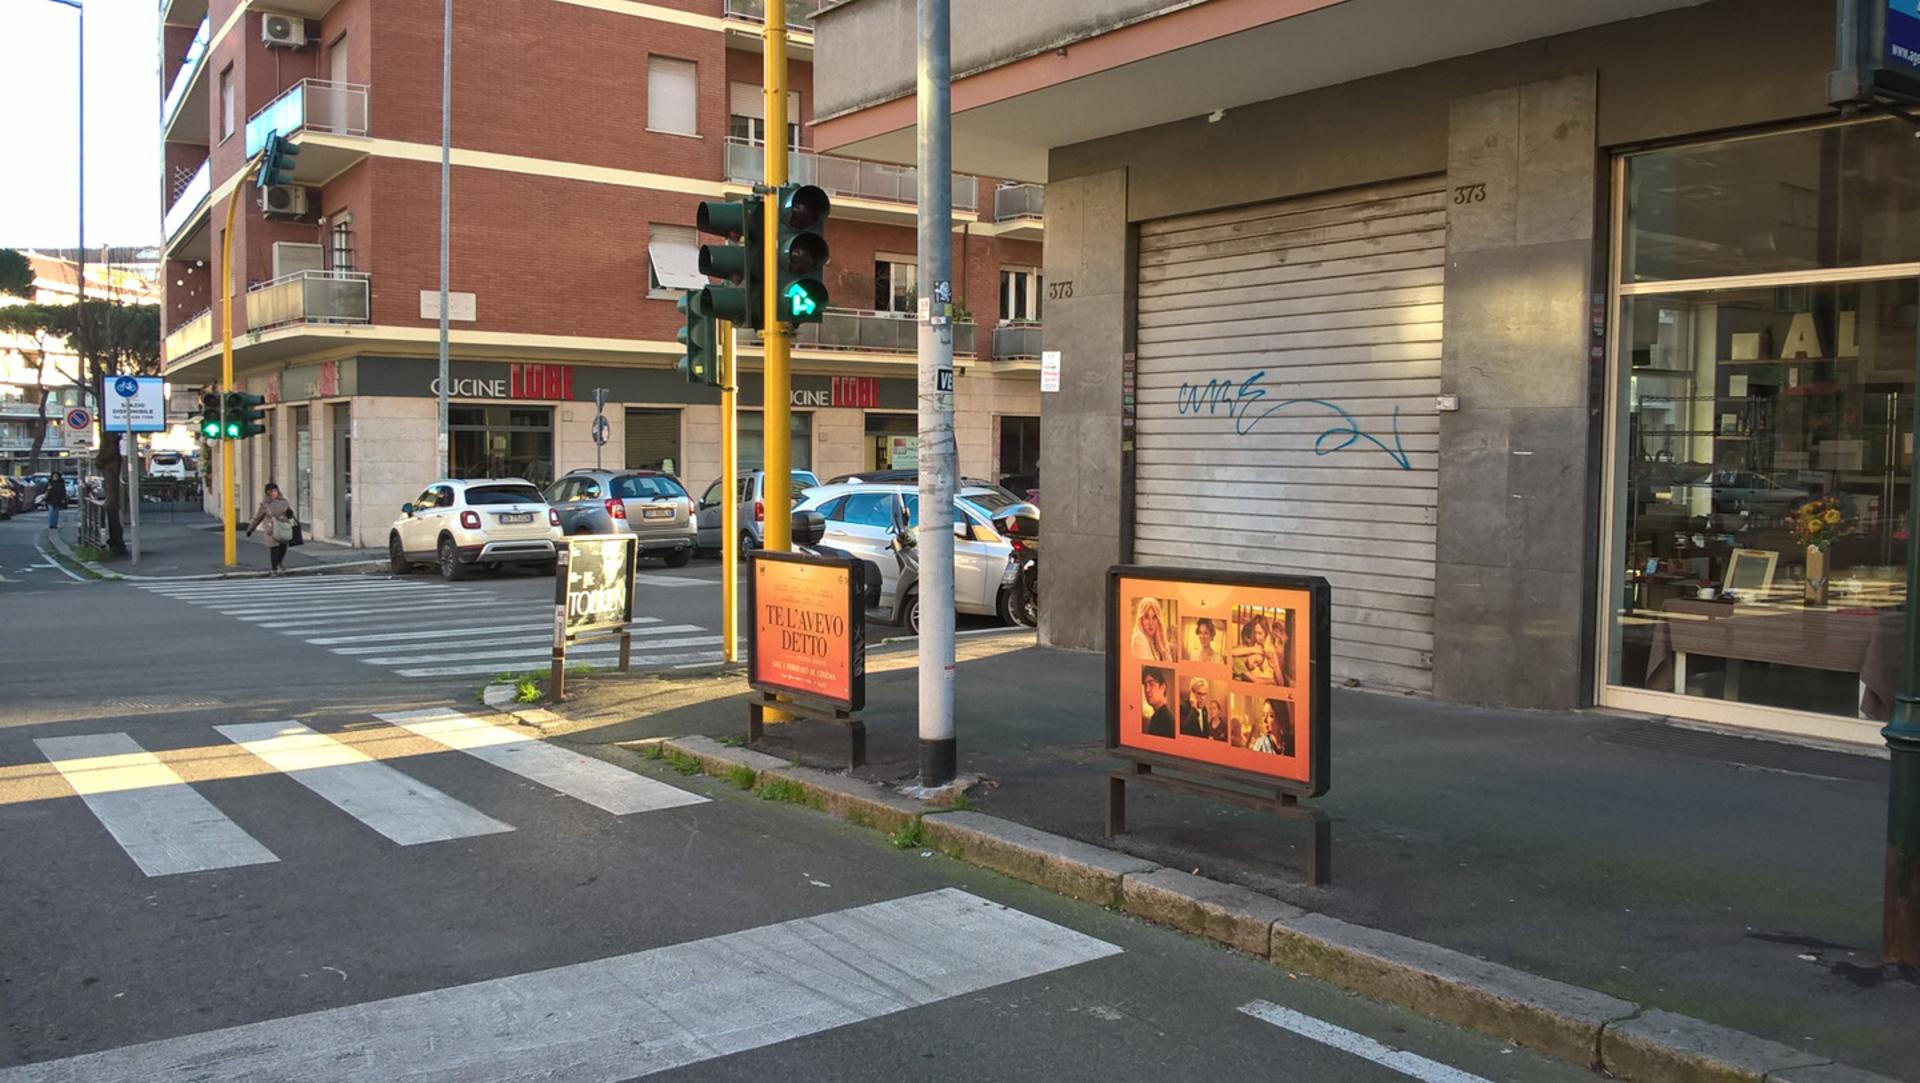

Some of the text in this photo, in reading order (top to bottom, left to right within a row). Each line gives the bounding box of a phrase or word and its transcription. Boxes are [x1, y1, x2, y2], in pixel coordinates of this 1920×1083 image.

[1454, 182, 1486, 205] 373
[1049, 281, 1073, 299] 373
[430, 362, 575, 400] CUCINE LUBE
[832, 376, 879, 408] LUBE
[765, 604, 844, 637] TE L'AVEVO
[782, 629, 828, 658] DETTO
